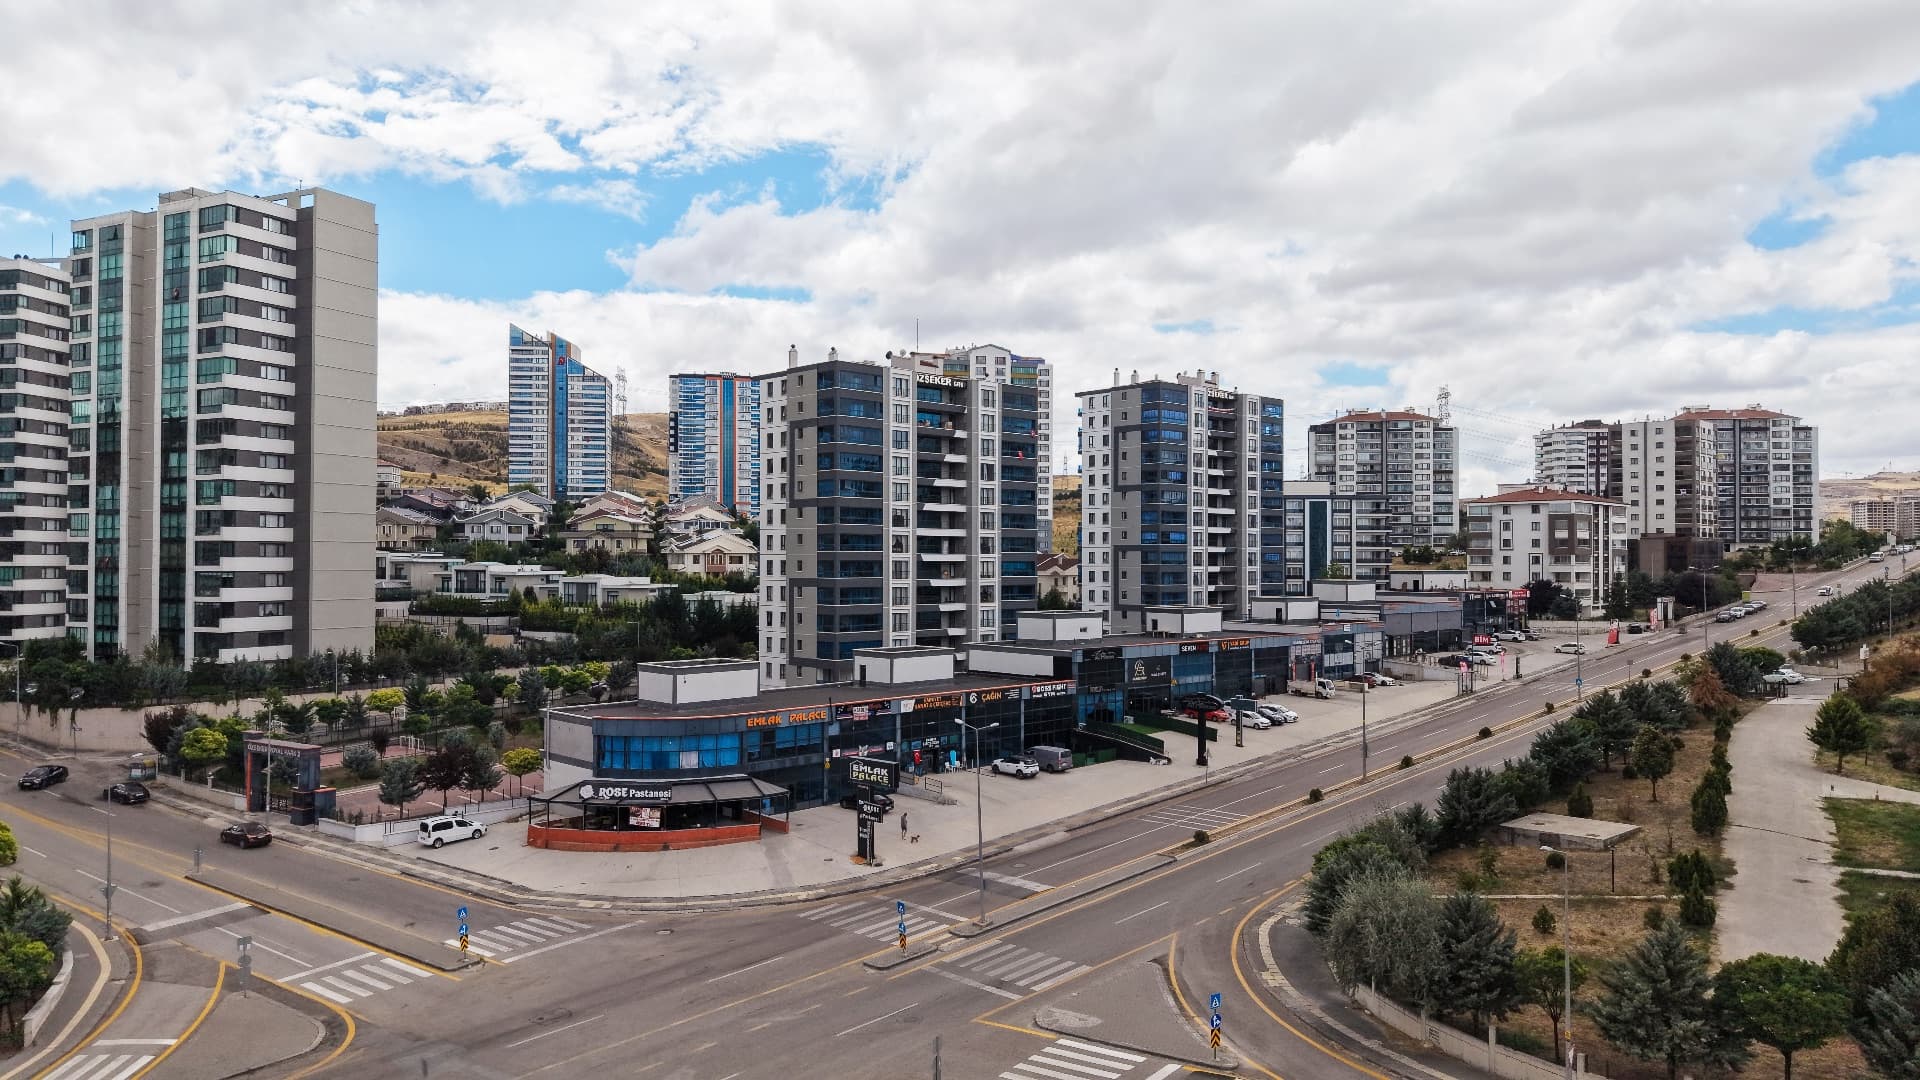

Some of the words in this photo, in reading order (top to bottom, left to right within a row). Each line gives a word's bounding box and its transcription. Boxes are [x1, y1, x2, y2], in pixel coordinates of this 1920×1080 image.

[747, 715, 782, 727] EMLAK
[789, 710, 828, 723] PALACE
[852, 764, 888, 776] EMLAK
[852, 771, 889, 783] PALACE
[599, 787, 628, 799] ROSE
